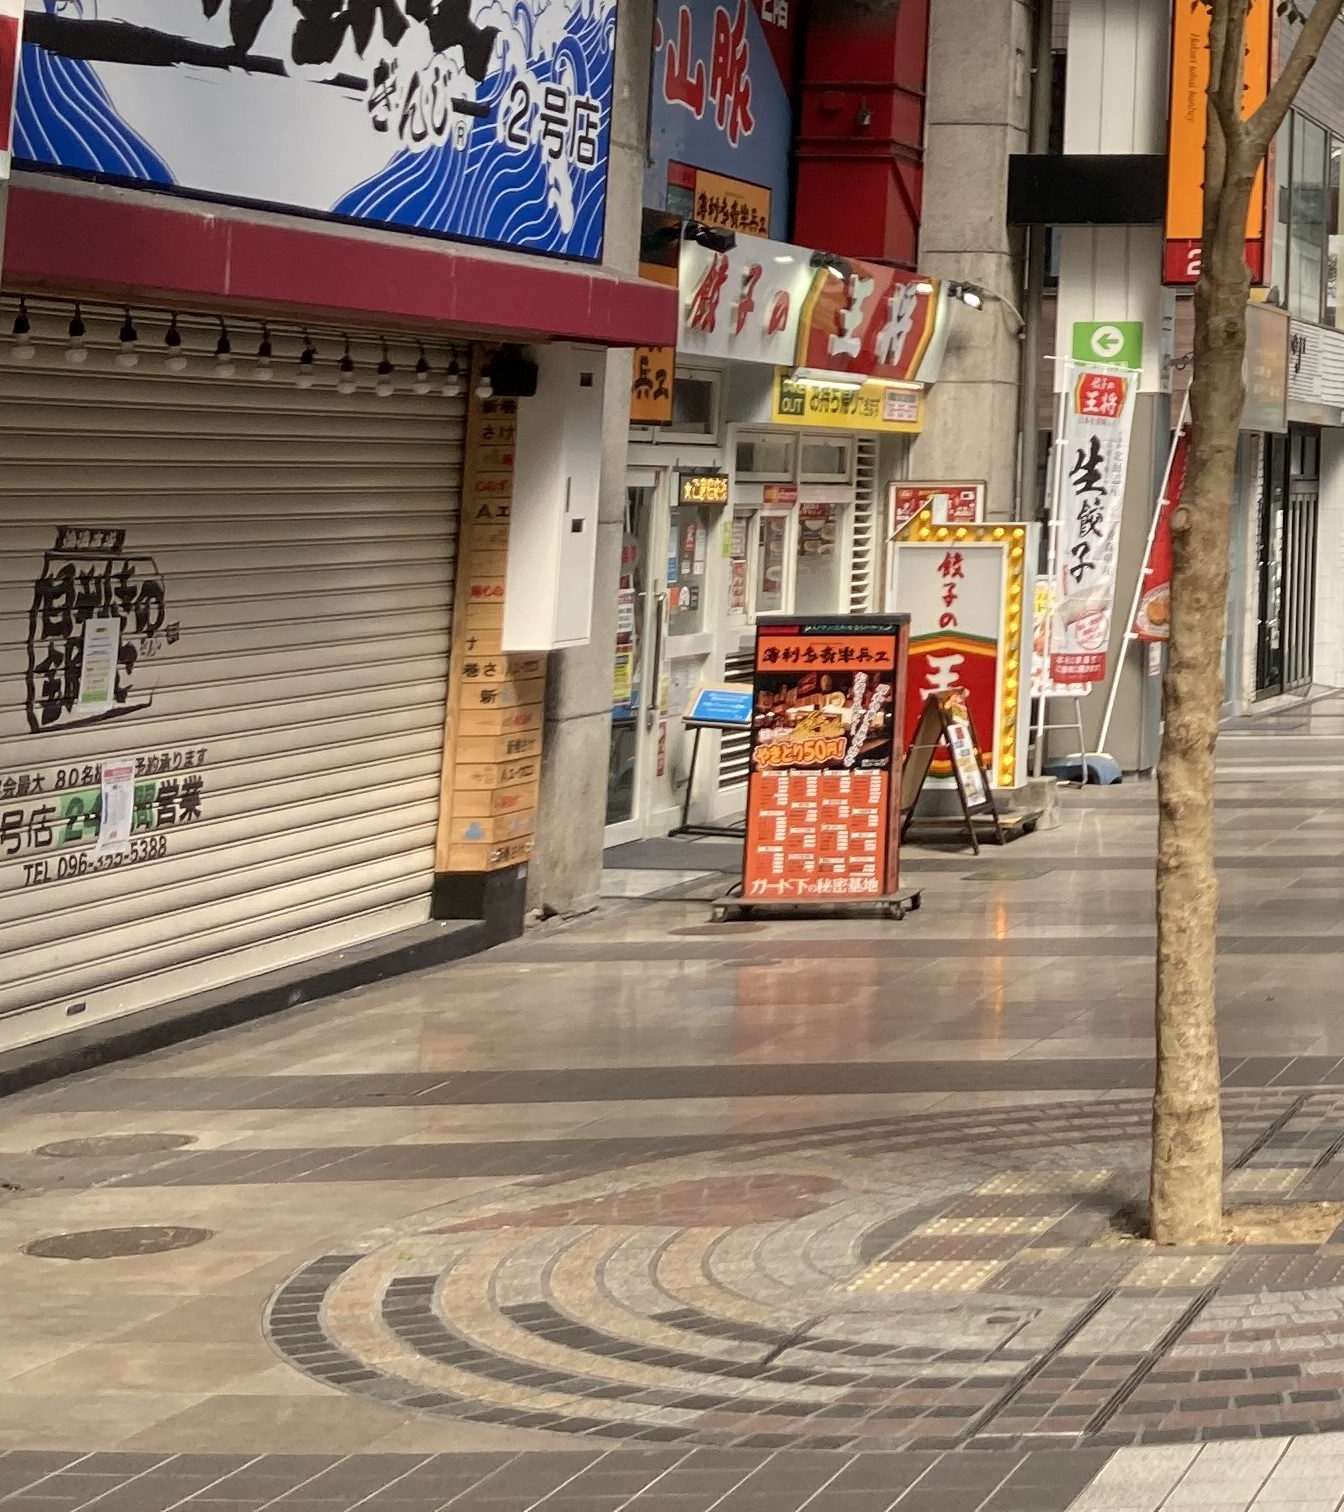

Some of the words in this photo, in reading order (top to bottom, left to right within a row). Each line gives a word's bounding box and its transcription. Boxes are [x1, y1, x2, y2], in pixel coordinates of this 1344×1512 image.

[508, 78, 602, 170] 2号店
[937, 550, 965, 629] 餃子の
[23, 861, 51, 885] TEL
